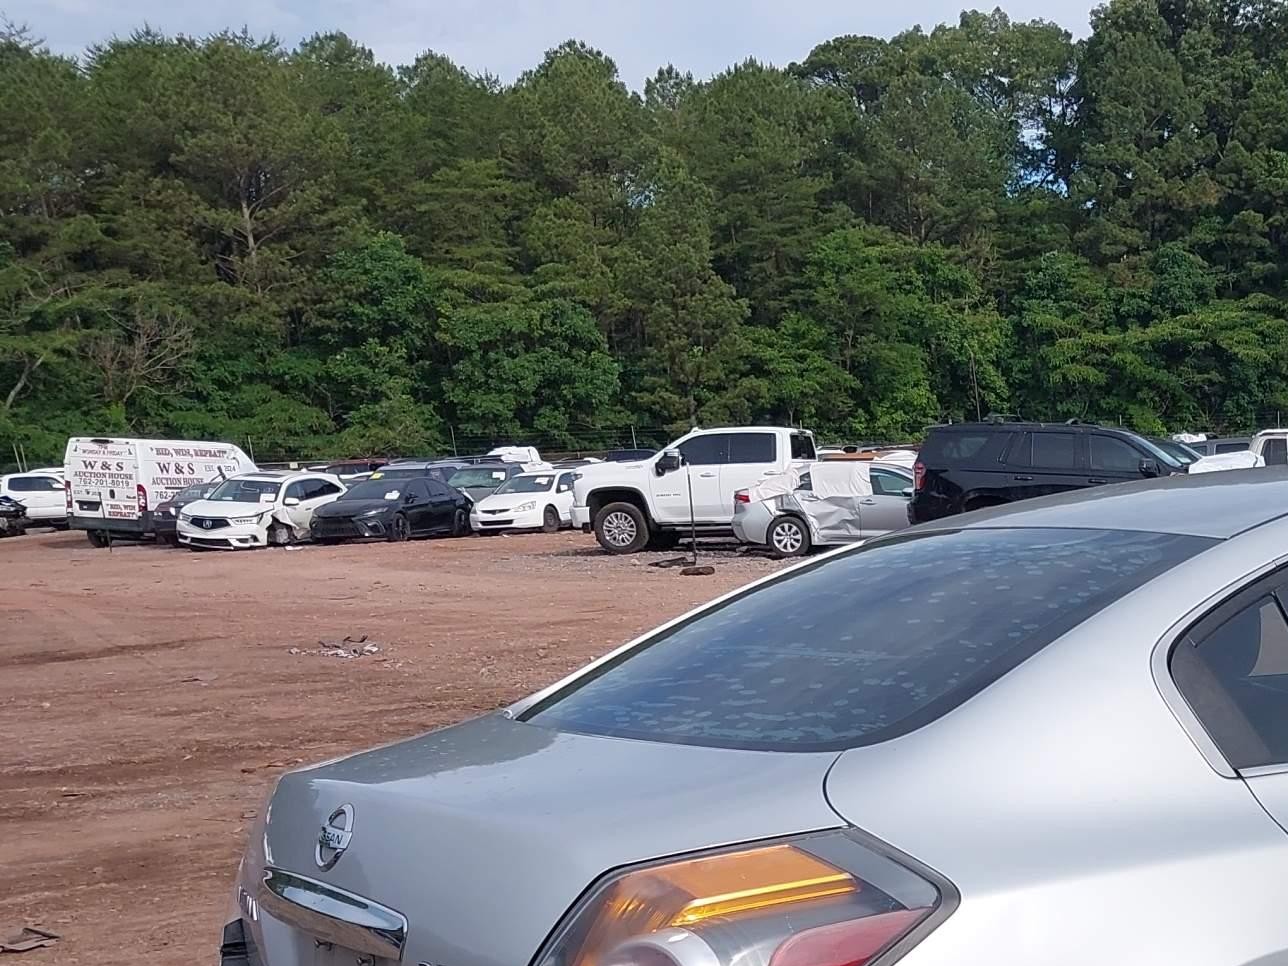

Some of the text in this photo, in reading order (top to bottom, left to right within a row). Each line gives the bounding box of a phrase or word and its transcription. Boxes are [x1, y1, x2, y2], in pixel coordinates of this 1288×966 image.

[81, 460, 124, 472] W & S
[156, 462, 195, 475] W & S
[73, 471, 134, 480] AUCTION HOUSE
[152, 477, 182, 485] AUCTION
